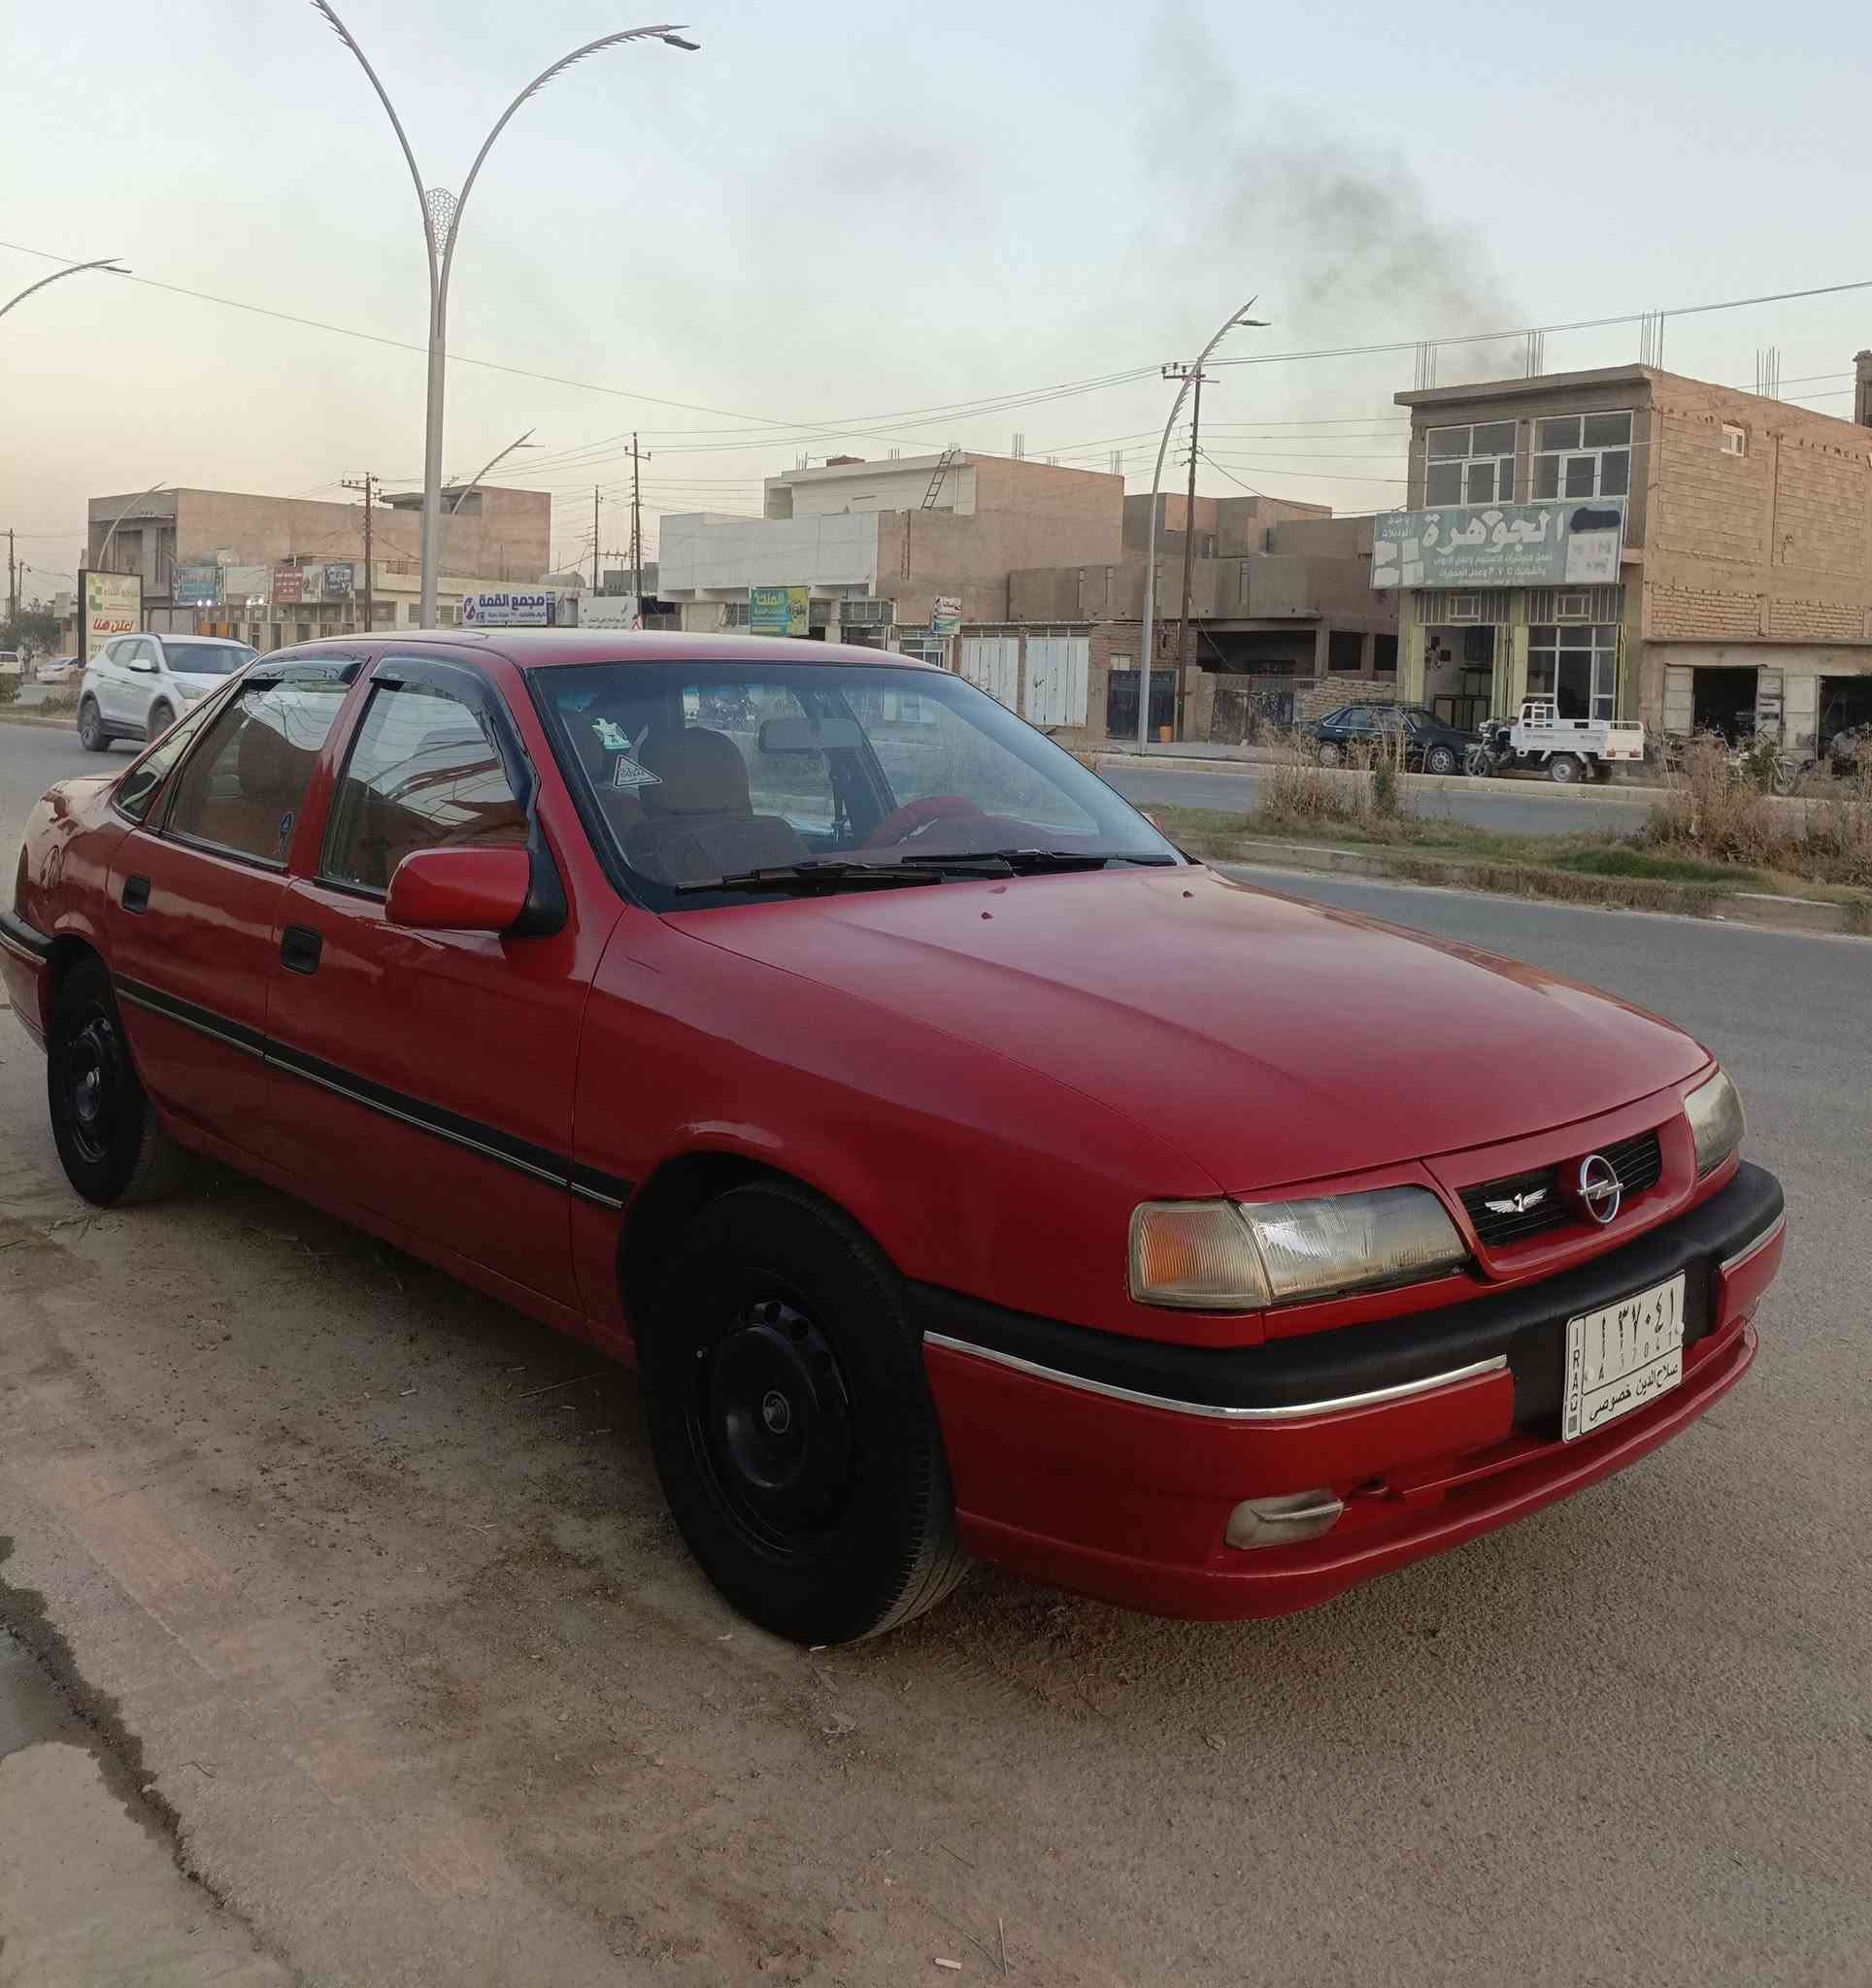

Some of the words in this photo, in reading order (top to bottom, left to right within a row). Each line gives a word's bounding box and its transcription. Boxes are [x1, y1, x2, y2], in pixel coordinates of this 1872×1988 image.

[1422, 508, 1564, 554] الجوهرة
[479, 594, 510, 608] القمة
[512, 596, 545, 611] مجمع
